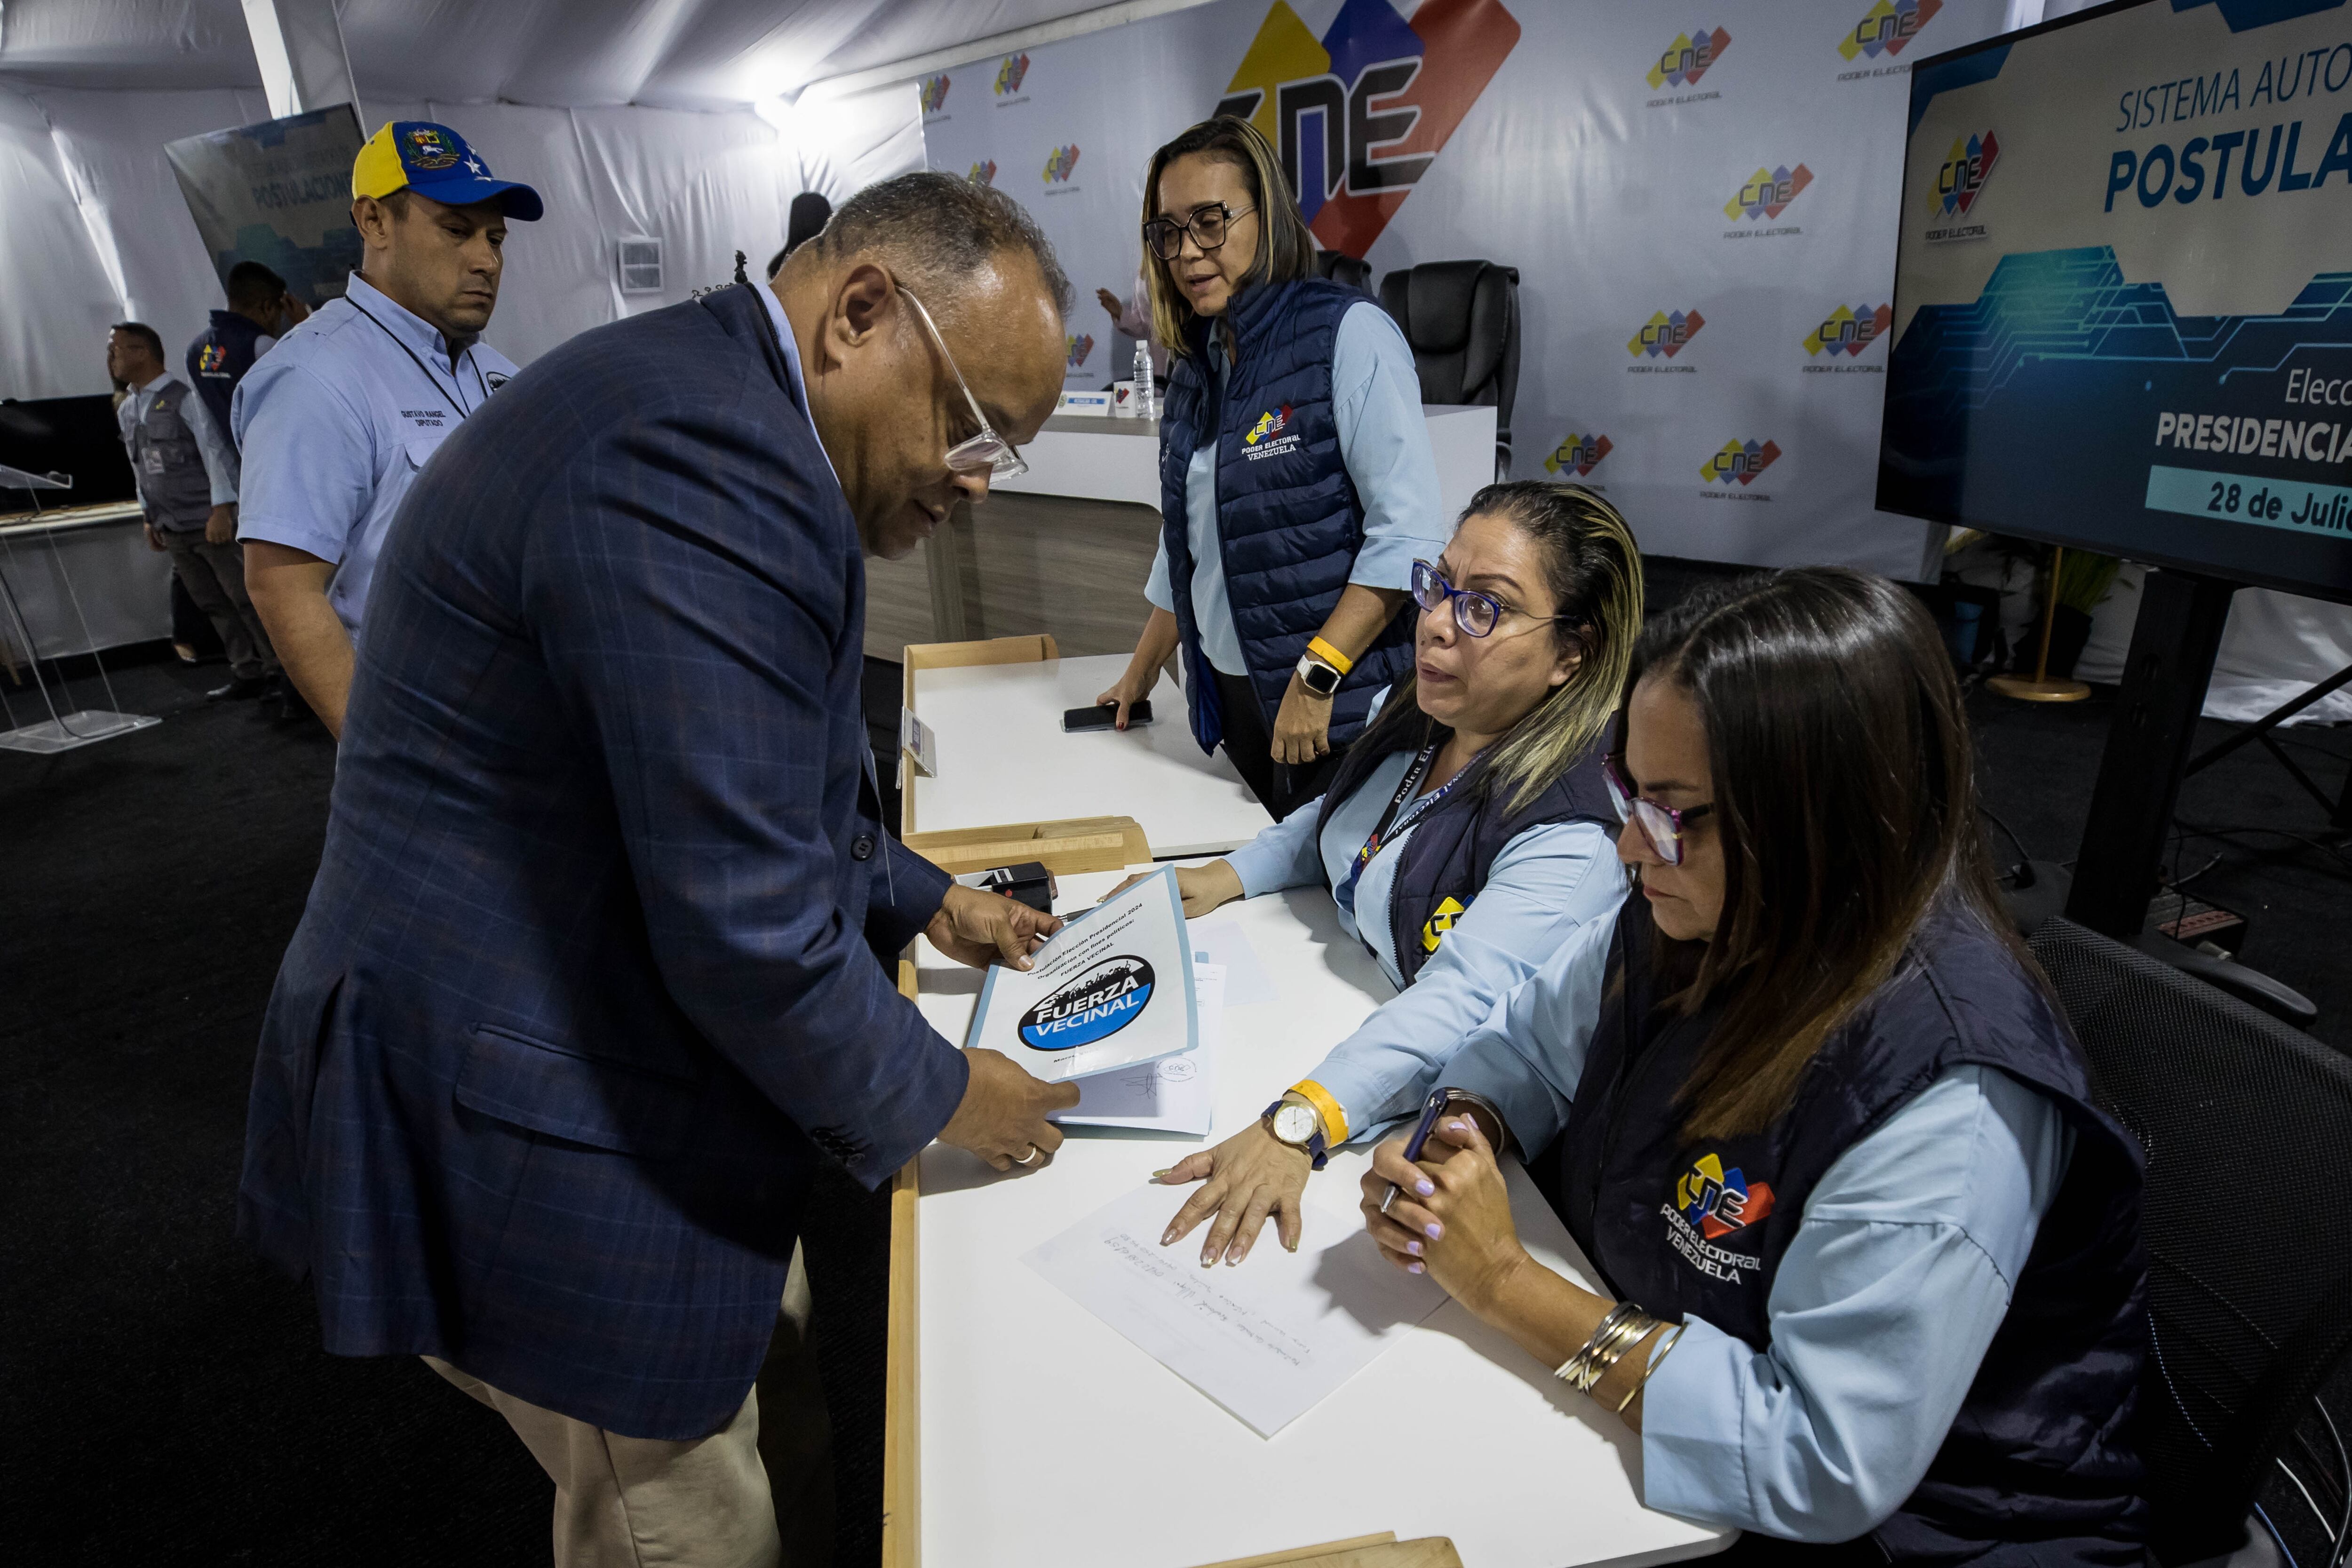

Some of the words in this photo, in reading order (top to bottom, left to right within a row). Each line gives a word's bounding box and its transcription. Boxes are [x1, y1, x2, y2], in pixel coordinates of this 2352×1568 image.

[2116, 67, 2240, 133] SISTEMA
[2250, 42, 2352, 111] AUTO
[2104, 112, 2352, 213] POSTULA
[2285, 367, 2352, 406] Elecc
[1242, 445, 1263, 454] PODER
[1248, 444, 1296, 461] VENEZUELA
[2207, 481, 2240, 514] 28
[2248, 486, 2282, 520] de
[1027, 954, 1062, 976] Postulación
[1062, 938, 1089, 956] Elección
[1089, 913, 1126, 940] Presidencial
[1128, 903, 1143, 915] 2024
[1037, 955, 1077, 979] Organización
[1078, 948, 1089, 957] con
[1090, 937, 1105, 949] fines
[1106, 919, 1135, 940] políticos:
[1061, 960, 1086, 977] FUERZA
[1087, 942, 1114, 960] VECINAL
[1035, 994, 1139, 1036] VECINAL
[1036, 975, 1139, 1024] FUERZA
[1660, 1203, 1691, 1241] PODER
[1666, 1225, 1742, 1285] VENEZUELA
